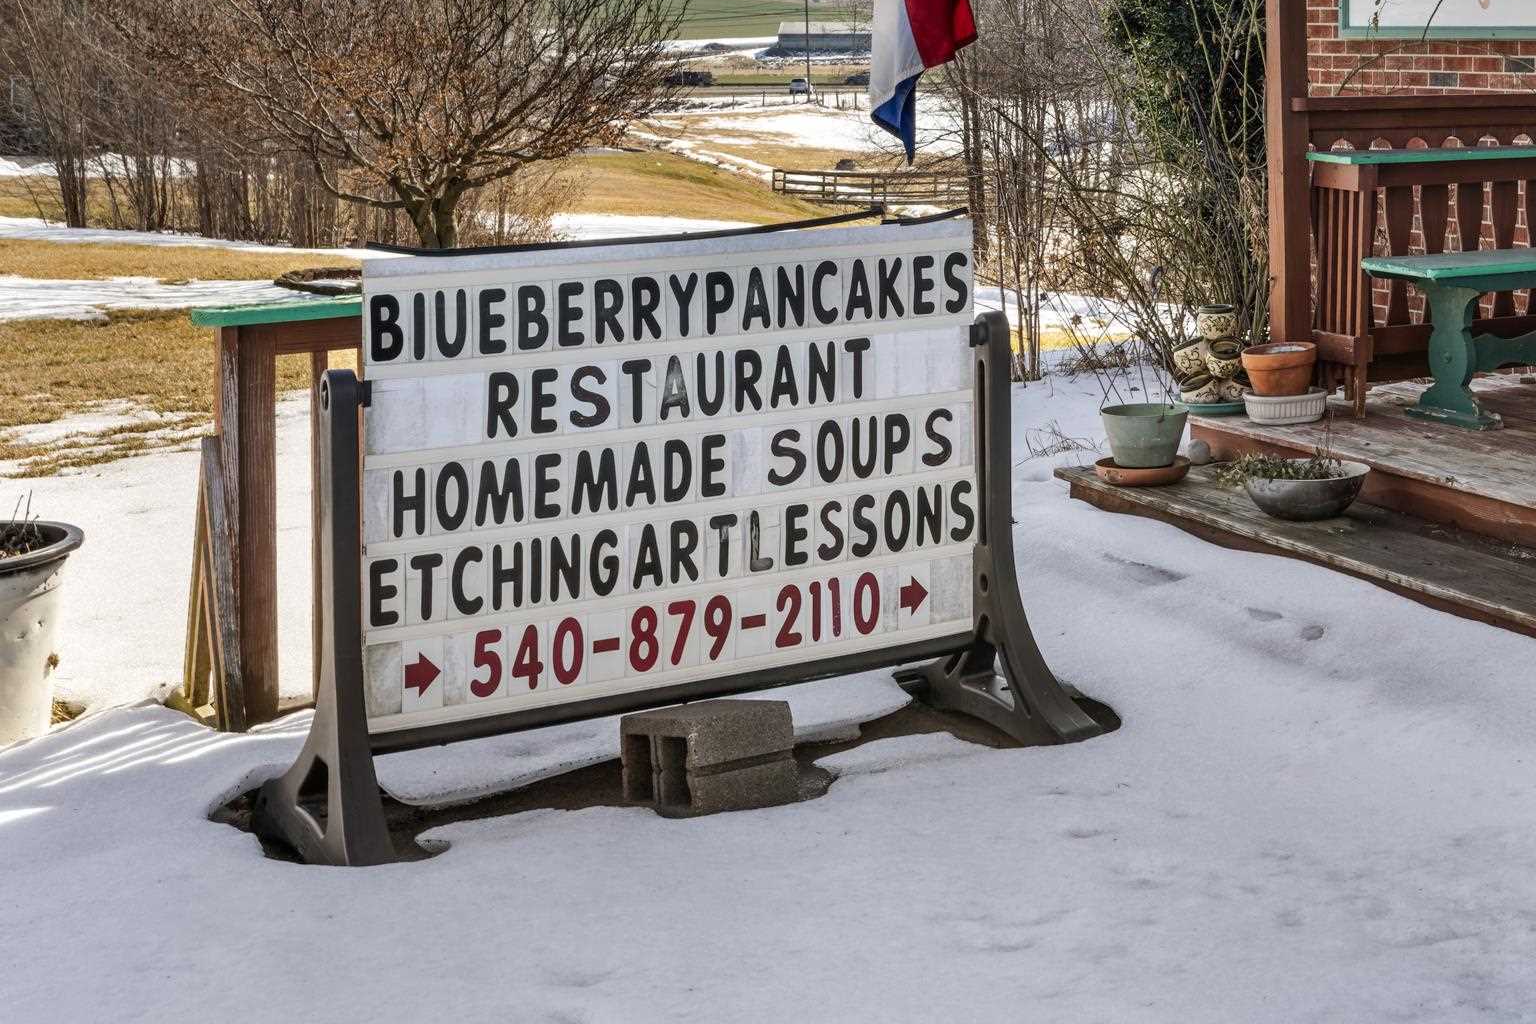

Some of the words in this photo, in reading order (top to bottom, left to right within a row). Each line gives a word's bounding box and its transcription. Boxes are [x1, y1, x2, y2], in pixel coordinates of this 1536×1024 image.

[487, 337, 870, 439] RESTAURANT
[393, 433, 726, 538] HOMEMADE
[767, 407, 953, 486] SOUPS
[470, 571, 880, 698] 540-879-2110
